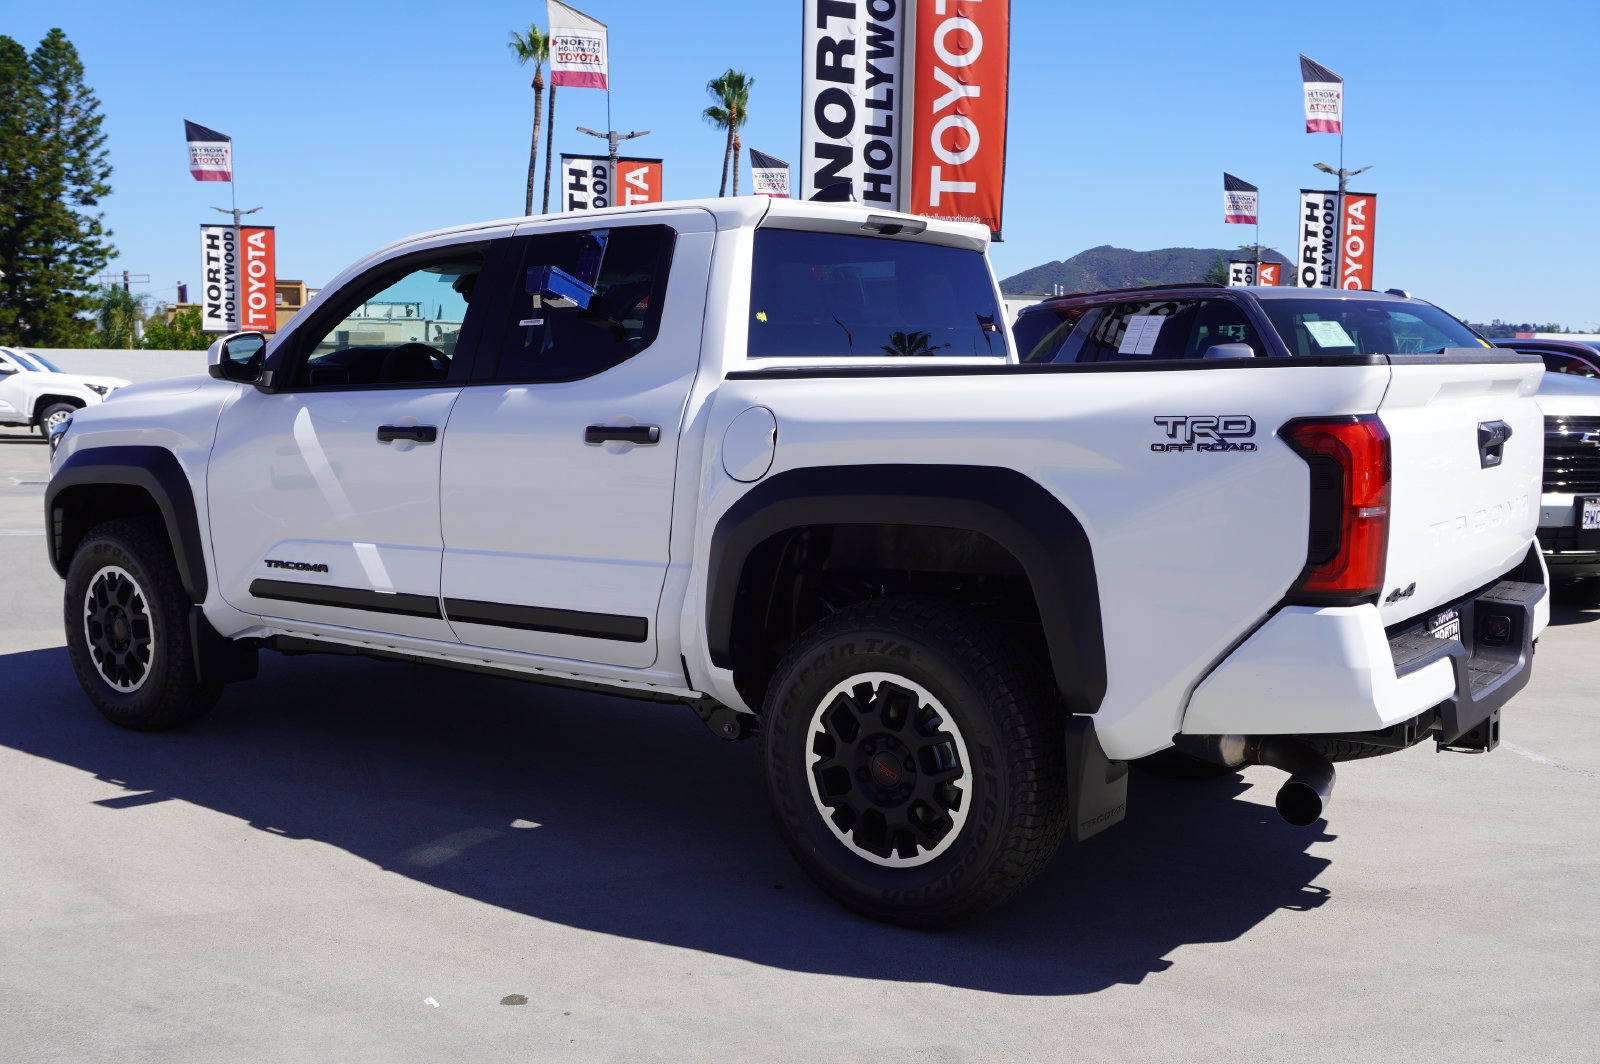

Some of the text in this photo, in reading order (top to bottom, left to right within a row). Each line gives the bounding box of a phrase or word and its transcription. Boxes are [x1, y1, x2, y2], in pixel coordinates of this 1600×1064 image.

[560, 39, 601, 48] NORTH
[558, 52, 601, 63] TOYOTA
[206, 233, 222, 319] NORTH
[223, 231, 236, 323] HOLLYWOOD
[247, 231, 267, 324] TOYOTA
[1153, 415, 1257, 444] TRD
[1151, 442, 1258, 452] OFF ROAD
[264, 559, 329, 573] TACOMA
